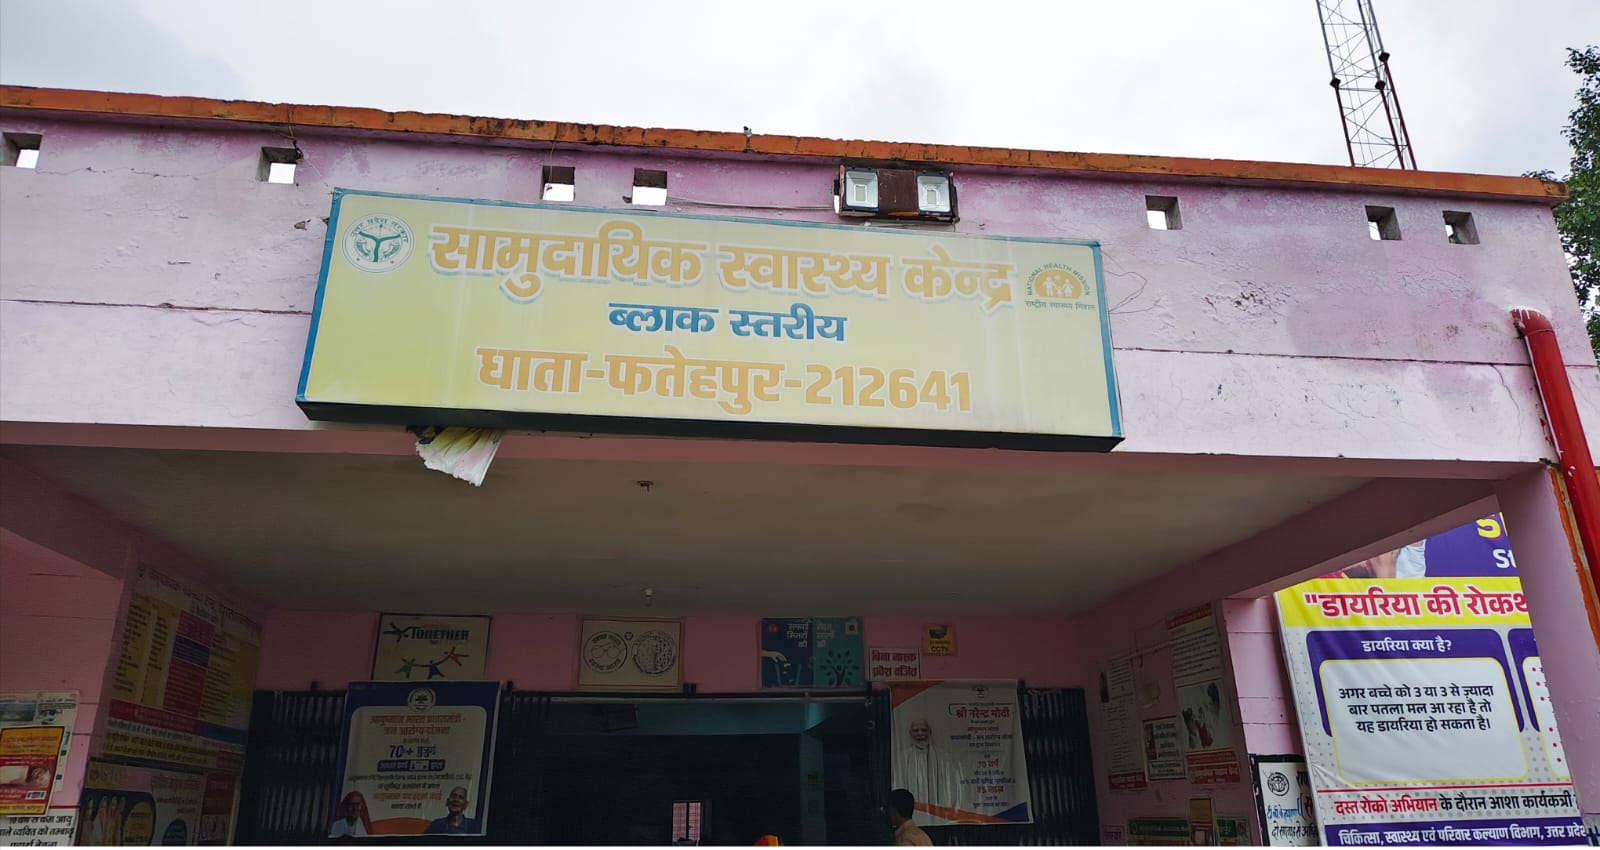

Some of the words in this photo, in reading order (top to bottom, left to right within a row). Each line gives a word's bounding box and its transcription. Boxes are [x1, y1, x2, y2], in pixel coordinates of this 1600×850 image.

[431, 221, 707, 300] सामुदायिक
[719, 244, 891, 297] स्वास्थ्य
[902, 243, 1016, 311] केन्द्र
[1026, 267, 1044, 296] NATIONAL
[1043, 263, 1072, 271] HEALTH
[1072, 270, 1091, 296] MISSION
[608, 302, 716, 333] ब्लाक
[729, 303, 848, 341] स्तरीय
[1305, 586, 1420, 616] "डायरिया
[1424, 586, 1460, 615] की
[1361, 636, 1410, 652] डायरिया
[1411, 639, 1434, 652] क्या
[1434, 635, 1452, 651] है?
[1339, 687, 1366, 699] अगर
[1368, 684, 1393, 698] बच्चे
[1394, 683, 1412, 698] को
[1414, 687, 1422, 697] 3
[1424, 686, 1438, 697] या
[1440, 686, 1448, 697] 3
[1450, 683, 1460, 697] से
[956, 706, 967, 718] श्री
[968, 707, 989, 718] नरेन्द्र
[991, 706, 1010, 718] मोदी
[1348, 703, 1368, 715] बार
[1370, 703, 1405, 715] पतला
[1406, 703, 1427, 714] मल
[1430, 703, 1445, 714] आ
[1447, 701, 1466, 713] रहा
[1467, 698, 1477, 713] है
[1478, 698, 1492, 712] तो
[1356, 720, 1375, 733] यह
[1376, 717, 1423, 732] डायरिया
[1424, 716, 1438, 732] हो
[1440, 718, 1475, 731] सकता
[1476, 714, 1491, 731] है।
[1334, 800, 1359, 815] दस्त
[1360, 795, 1389, 814] रोको
[1390, 794, 1438, 813] अभियान
[1439, 793, 1453, 811] के
[1454, 792, 1486, 811] दौरान
[1488, 796, 1521, 810] आशा
[37, 825, 49, 836] को
[1338, 829, 1384, 845] चिकित्सा,
[1384, 830, 1420, 844] स्वास्थ्य
[1421, 827, 1436, 842] एवं
[1437, 825, 1471, 842] परिवार
[1471, 826, 1509, 840] कल्याण
[1509, 823, 1544, 840] विभाग,
[1544, 825, 1566, 838] उत्तर
